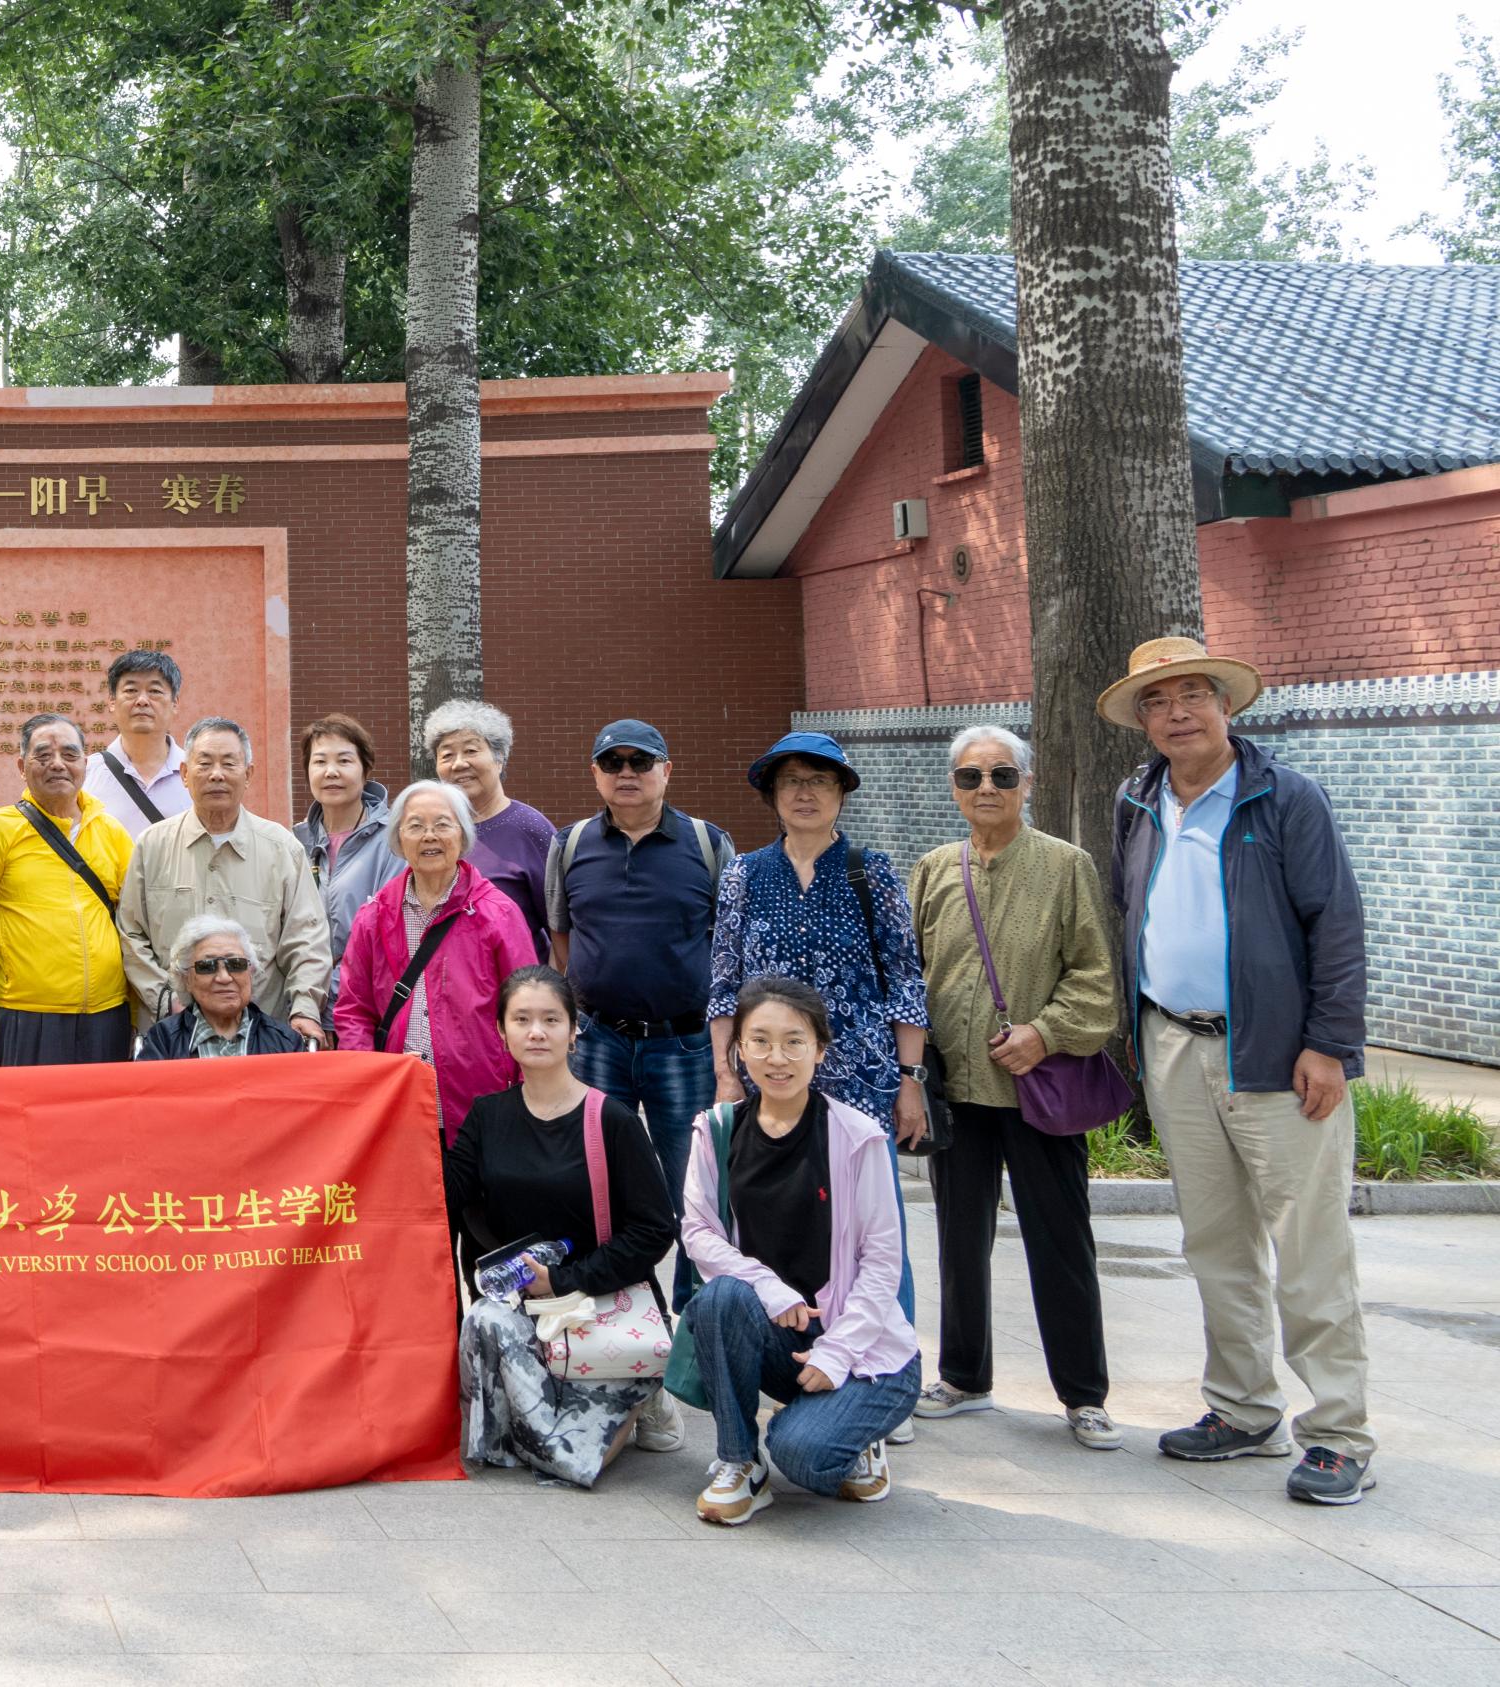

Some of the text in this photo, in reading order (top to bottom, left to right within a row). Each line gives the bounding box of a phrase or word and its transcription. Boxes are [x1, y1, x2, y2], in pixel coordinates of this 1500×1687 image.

[956, 551, 967, 576] 9
[97, 1182, 358, 1234] 公共卫生学院
[95, 1254, 178, 1273] SCHOOL
[181, 1254, 207, 1272] OF
[212, 1247, 287, 1271] PUBLIC
[291, 1243, 363, 1265] HEALTH
